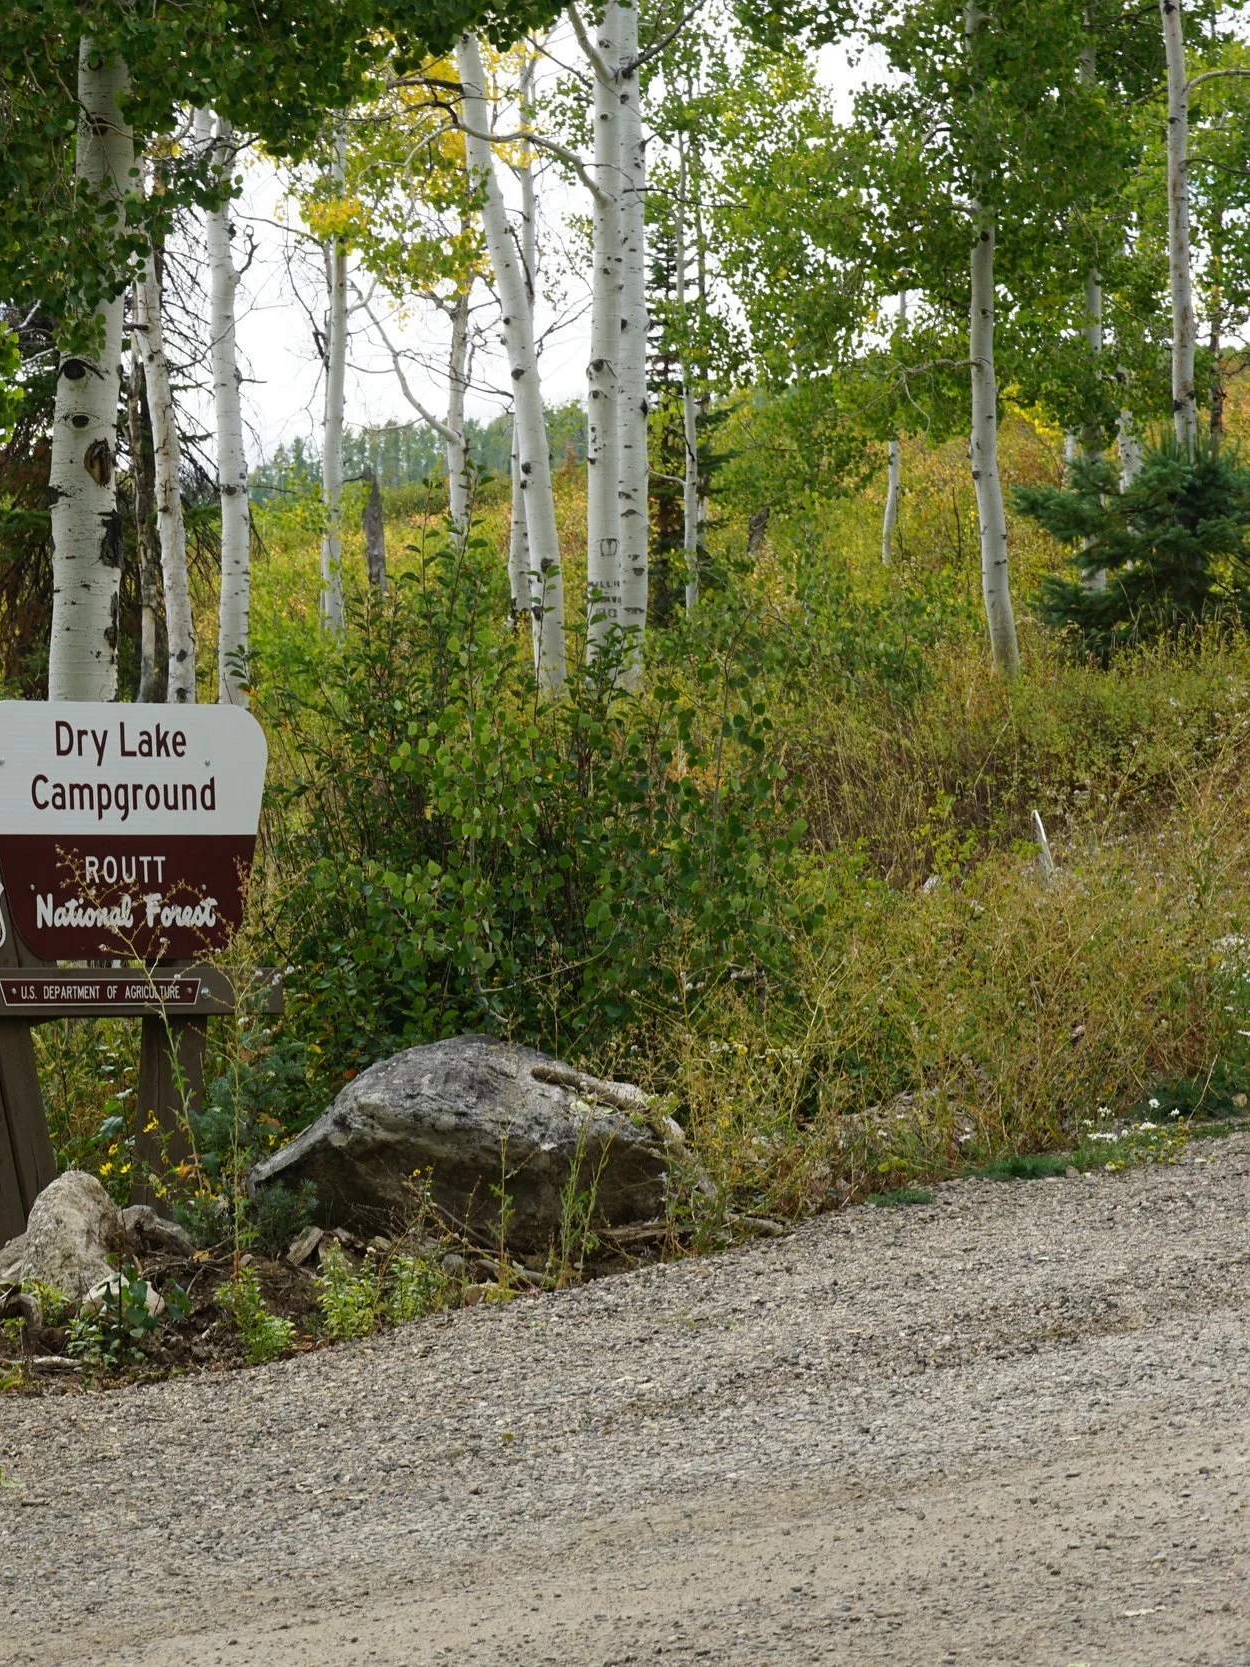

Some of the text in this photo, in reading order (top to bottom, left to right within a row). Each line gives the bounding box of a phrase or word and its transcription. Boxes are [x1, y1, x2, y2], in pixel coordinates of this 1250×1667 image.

[55, 720, 187, 767] Dry Lake
[31, 774, 216, 822] Campground
[85, 856, 166, 883] ROUTT
[36, 892, 219, 929] National Forest
[20, 985, 38, 999] U.S.
[43, 985, 100, 999] DEPARTMENT
[106, 985, 118, 999] OF
